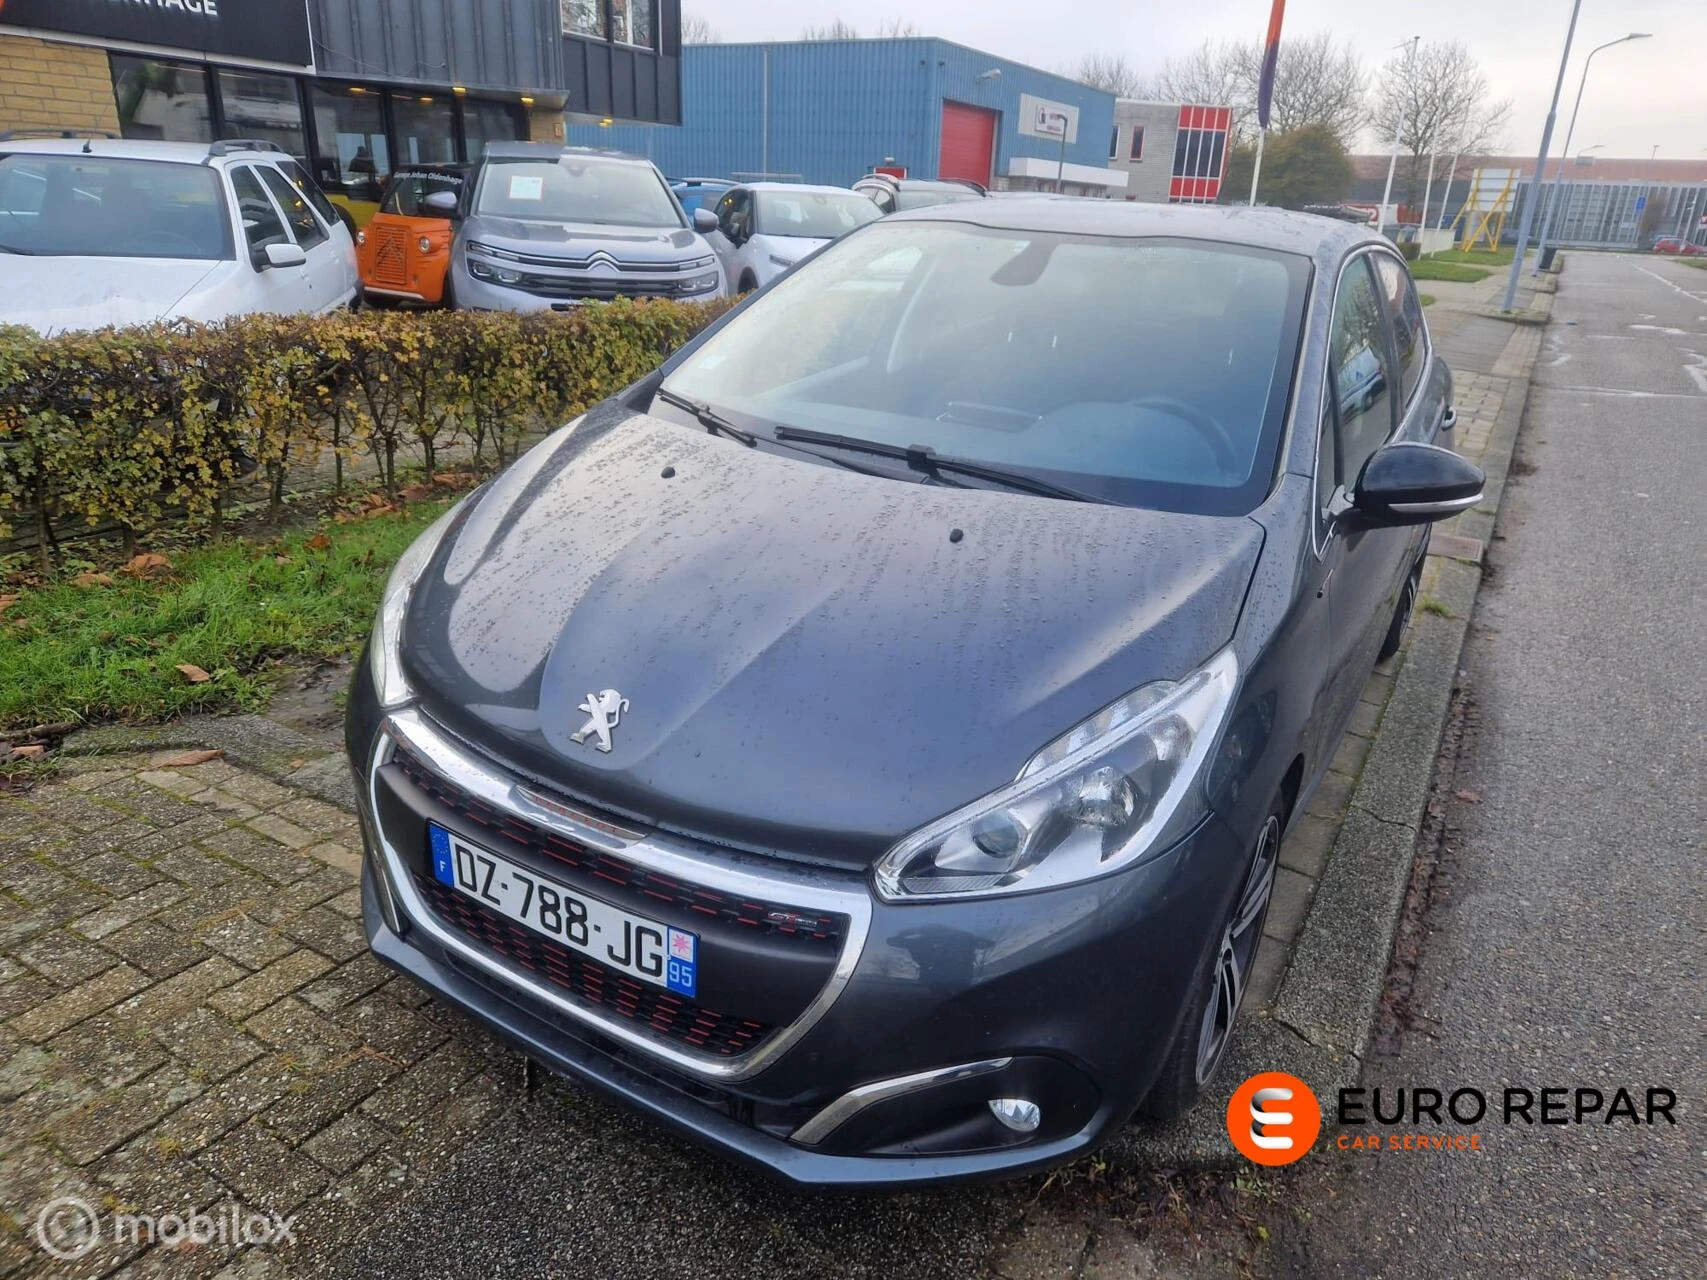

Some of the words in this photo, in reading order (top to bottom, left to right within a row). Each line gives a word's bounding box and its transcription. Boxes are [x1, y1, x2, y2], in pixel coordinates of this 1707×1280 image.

[440, 860, 446, 872] F
[455, 843, 663, 978] DZ-788-JG
[669, 961, 692, 988] 95
